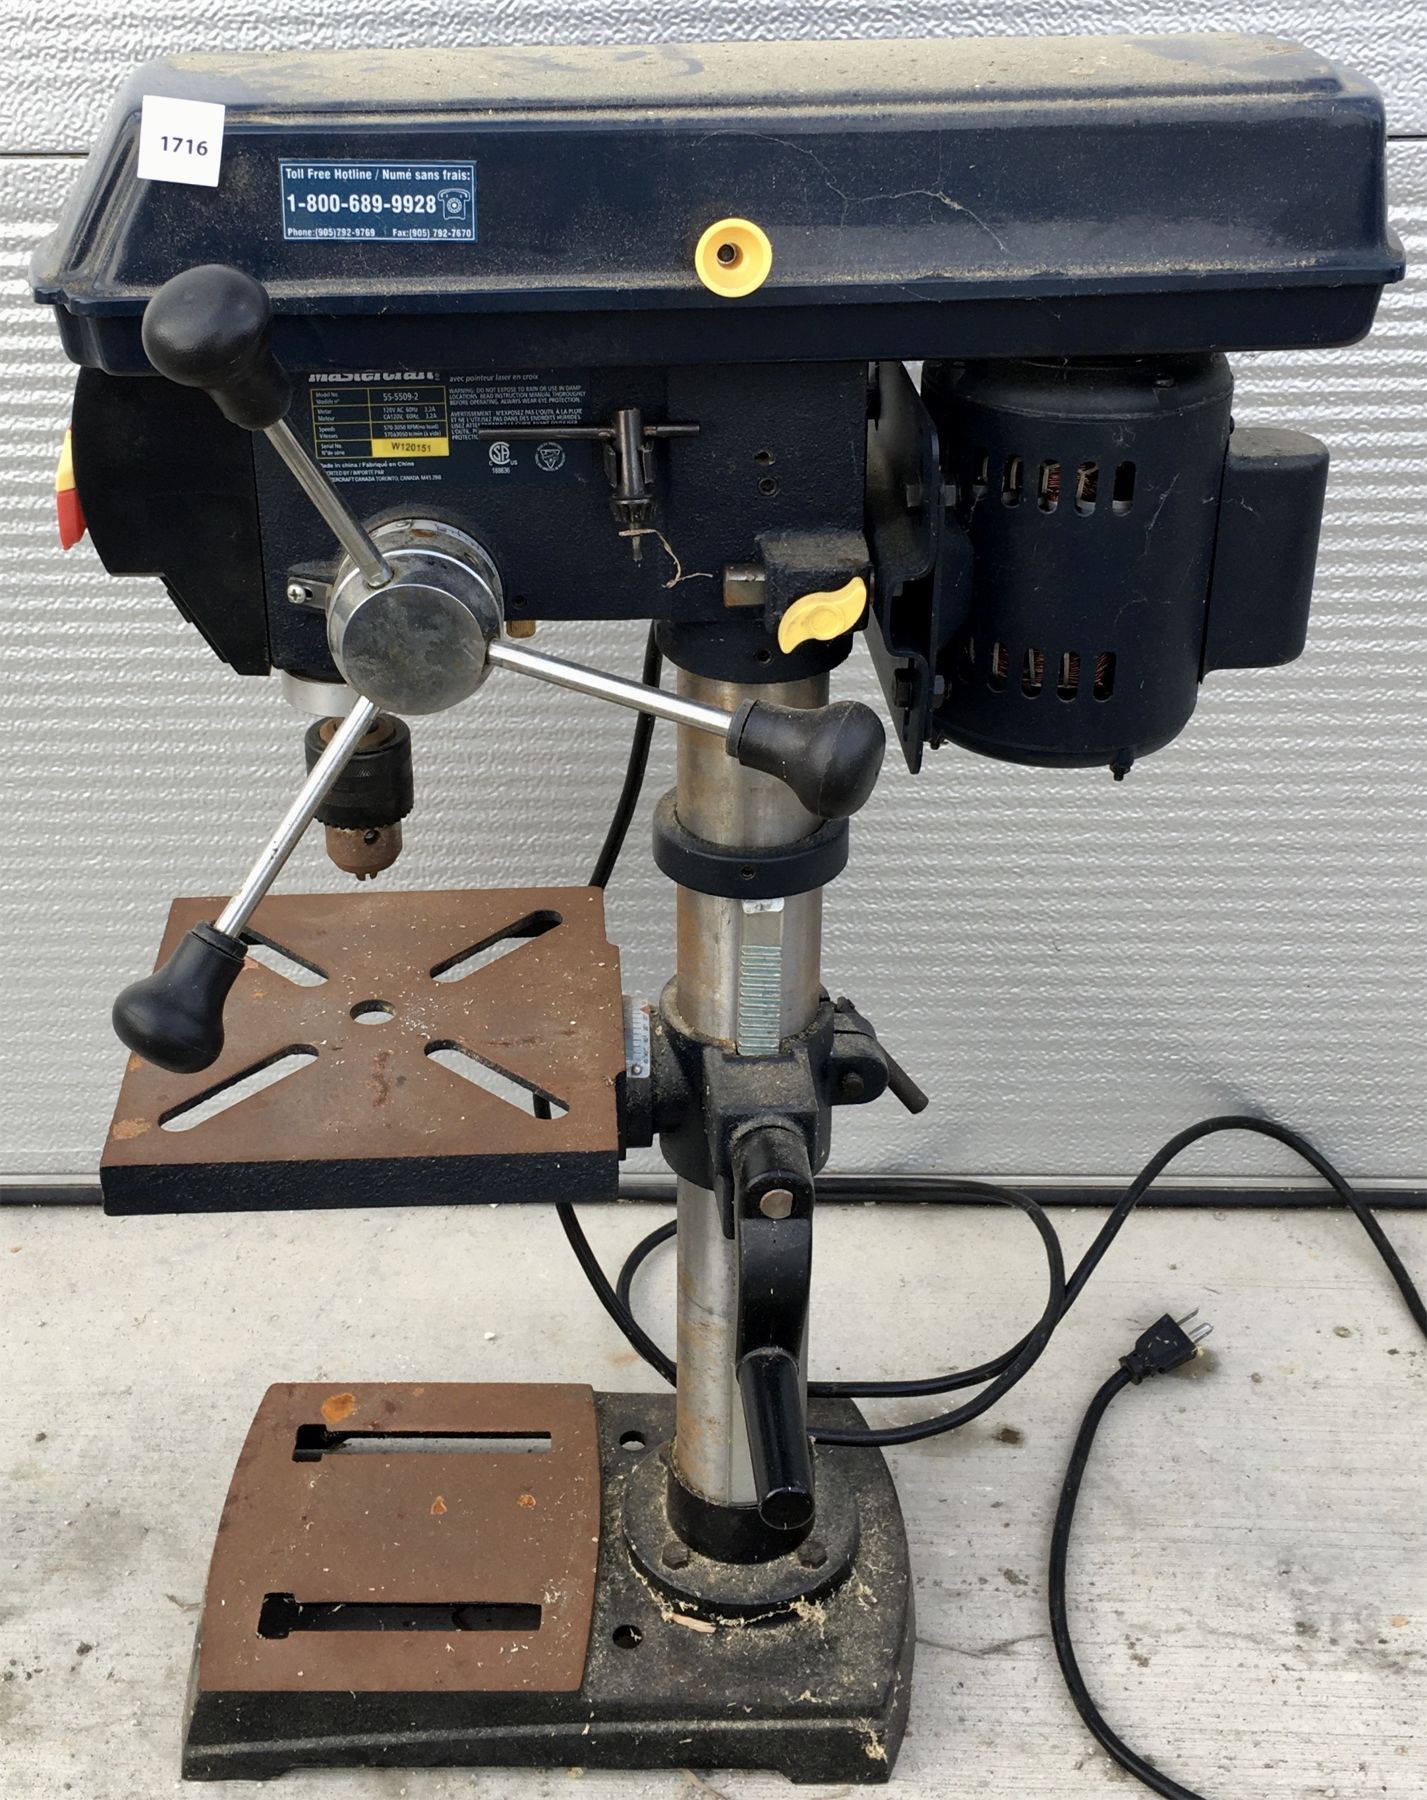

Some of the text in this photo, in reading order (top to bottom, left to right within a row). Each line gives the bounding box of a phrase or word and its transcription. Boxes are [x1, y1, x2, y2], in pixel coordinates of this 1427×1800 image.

[161, 136, 208, 156] 1716
[286, 168, 304, 179] Toll
[307, 168, 331, 179] Free
[334, 169, 372, 180] Hotline
[382, 169, 412, 180] Numé
[415, 171, 440, 180] sans
[443, 169, 471, 181] frais:
[287, 194, 437, 213] 1-800-689-9928
[433, 228, 471, 238] 792-7670
[495, 373, 511, 381] laser
[522, 373, 539, 381] croix
[391, 442, 432, 452] W120151
